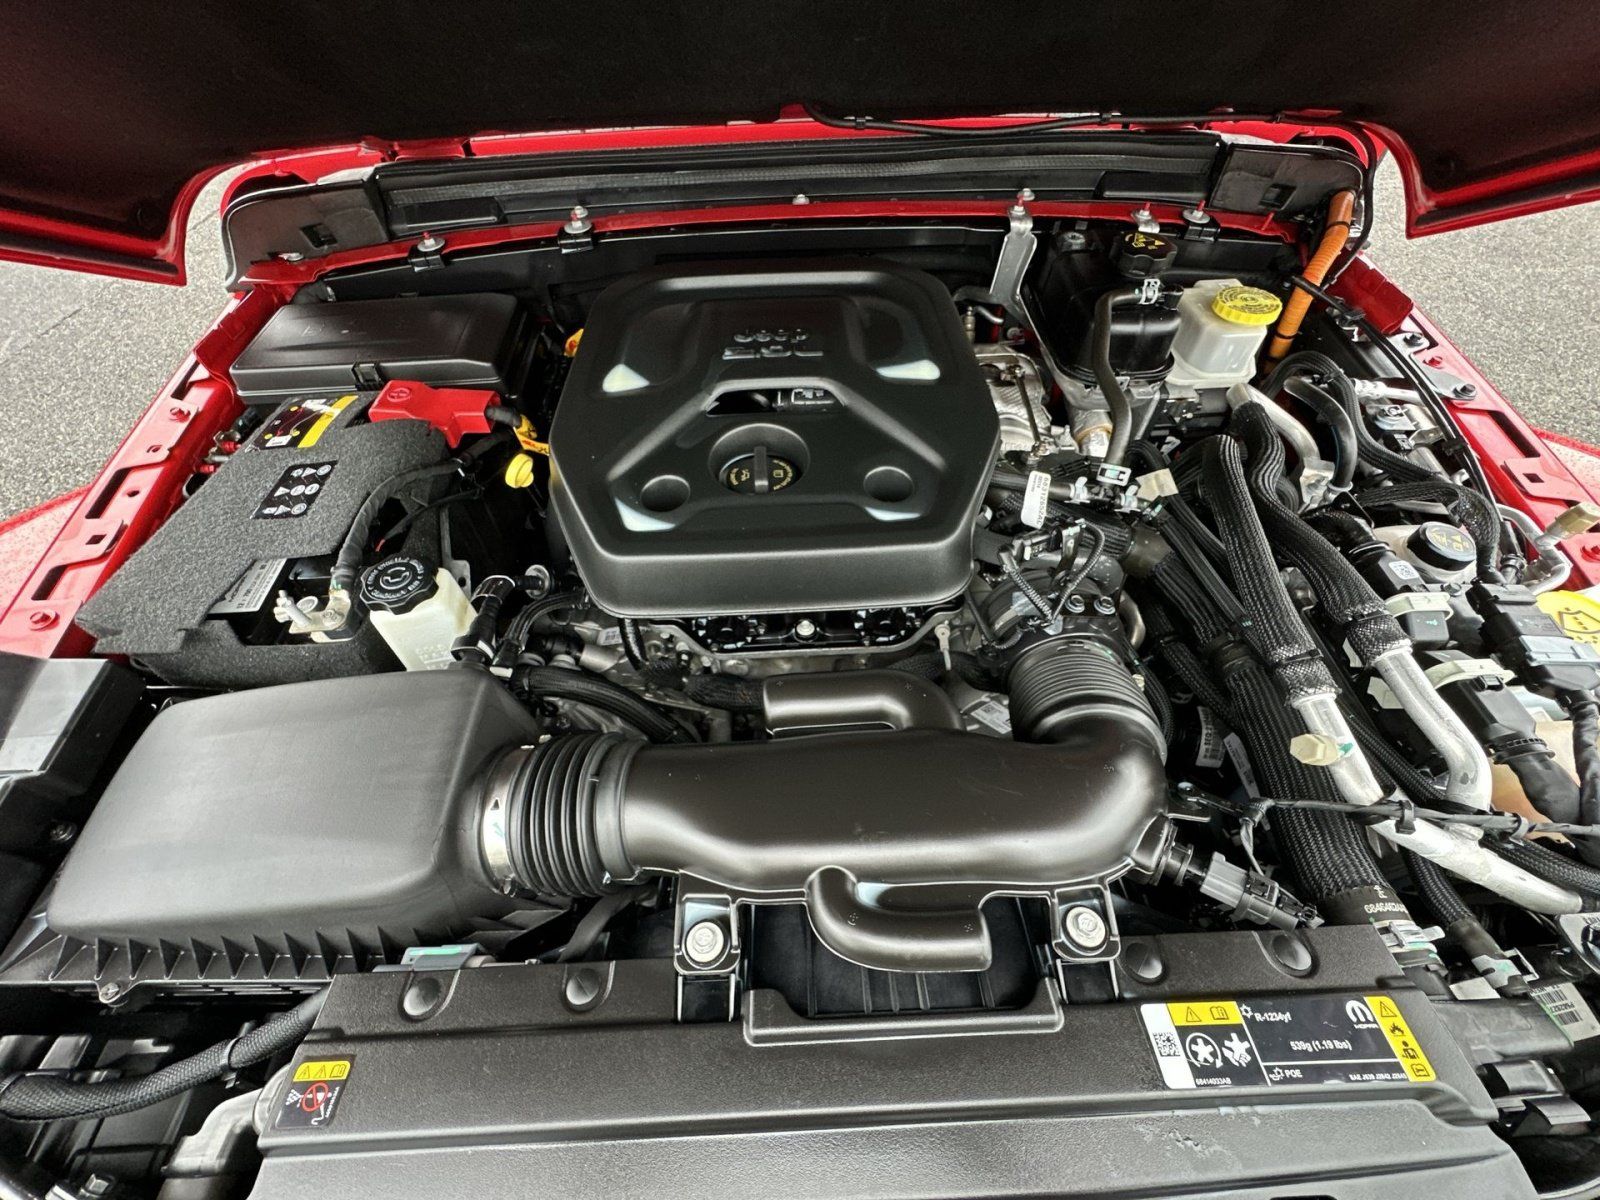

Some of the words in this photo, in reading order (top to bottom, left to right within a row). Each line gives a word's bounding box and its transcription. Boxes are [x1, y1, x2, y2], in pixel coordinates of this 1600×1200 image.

[1289, 1040, 1314, 1052] 539g
[1311, 1039, 1334, 1052] (1.19
[1333, 1039, 1353, 1051] lbs)
[1284, 1068, 1303, 1078] POE
